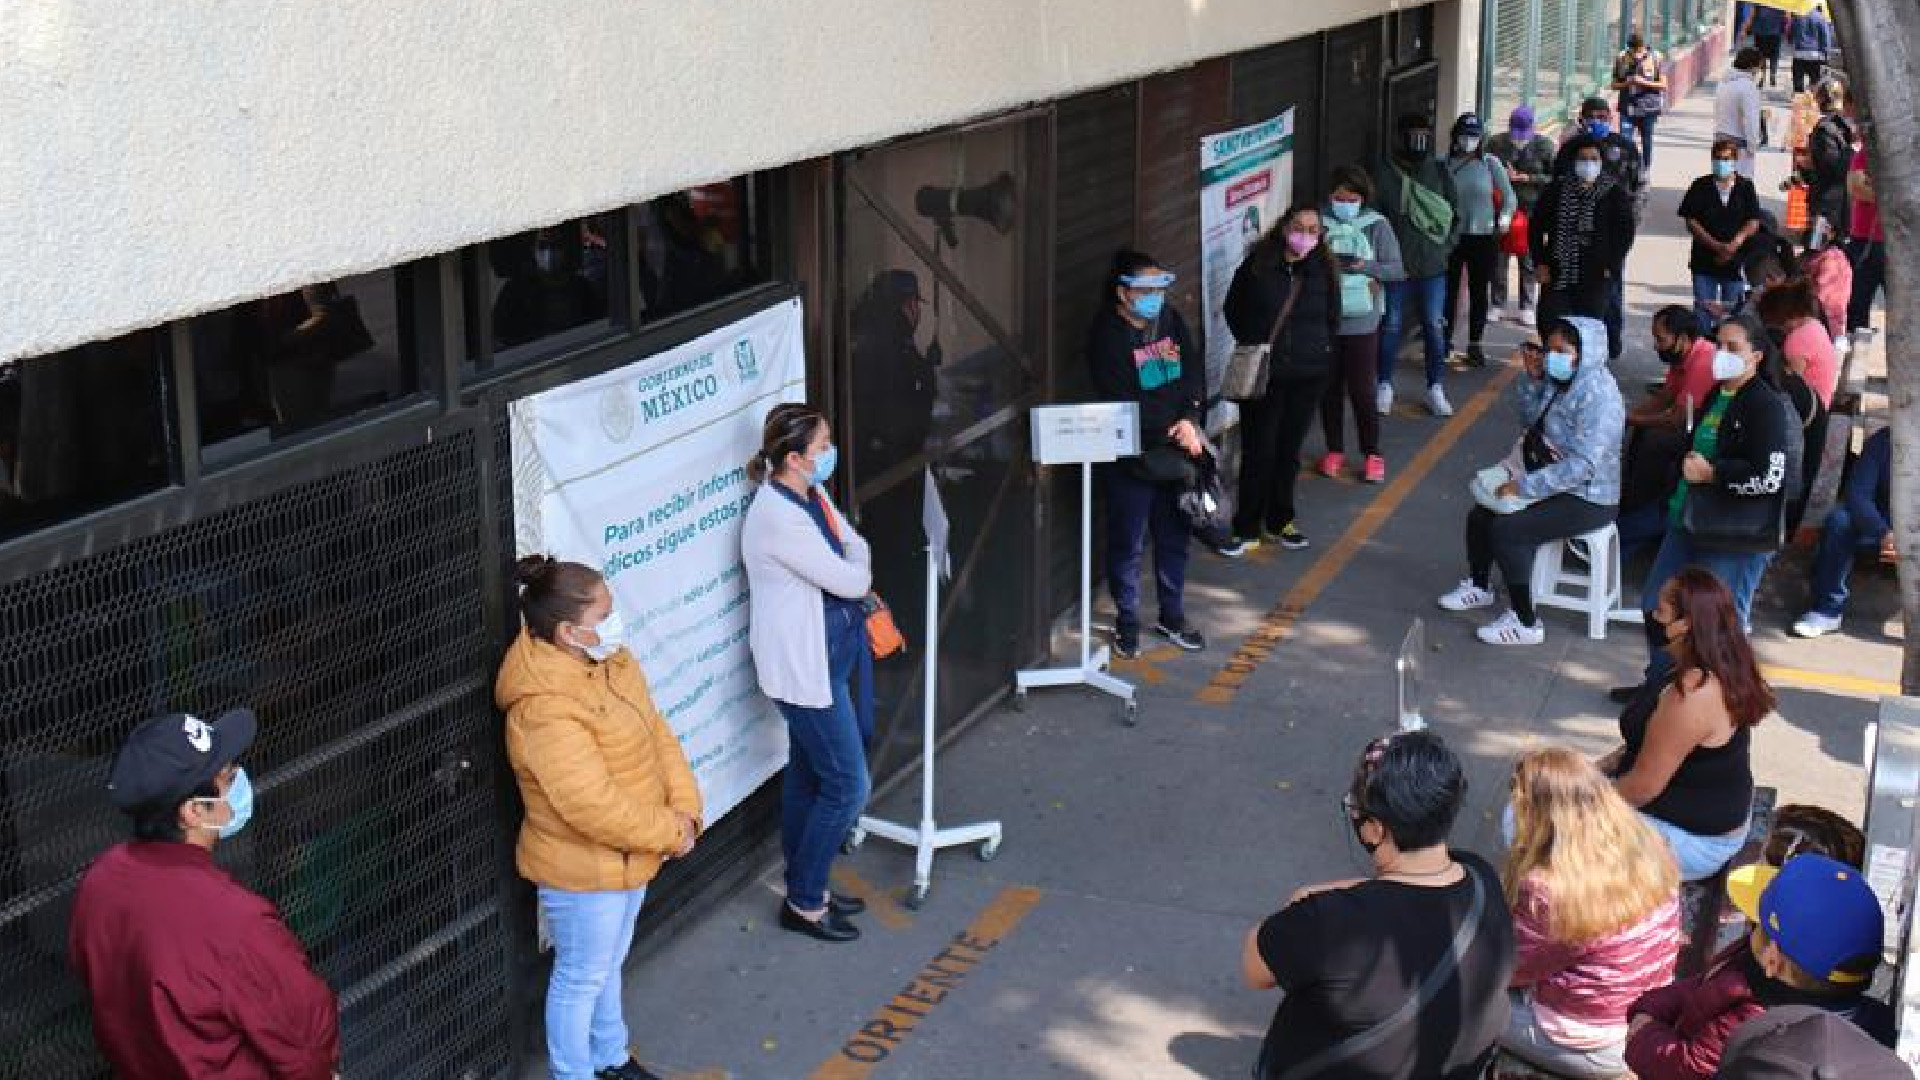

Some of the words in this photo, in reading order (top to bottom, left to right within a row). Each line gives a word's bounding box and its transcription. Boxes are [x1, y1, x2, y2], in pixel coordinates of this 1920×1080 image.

[638, 358, 697, 393] GOBIERNO
[640, 373, 717, 424] MÉXICO
[604, 516, 645, 546] Para
[647, 487, 695, 528] recibir
[656, 523, 697, 554] sigue
[699, 500, 738, 531] estos
[842, 931, 1000, 1063] ORIENTE
